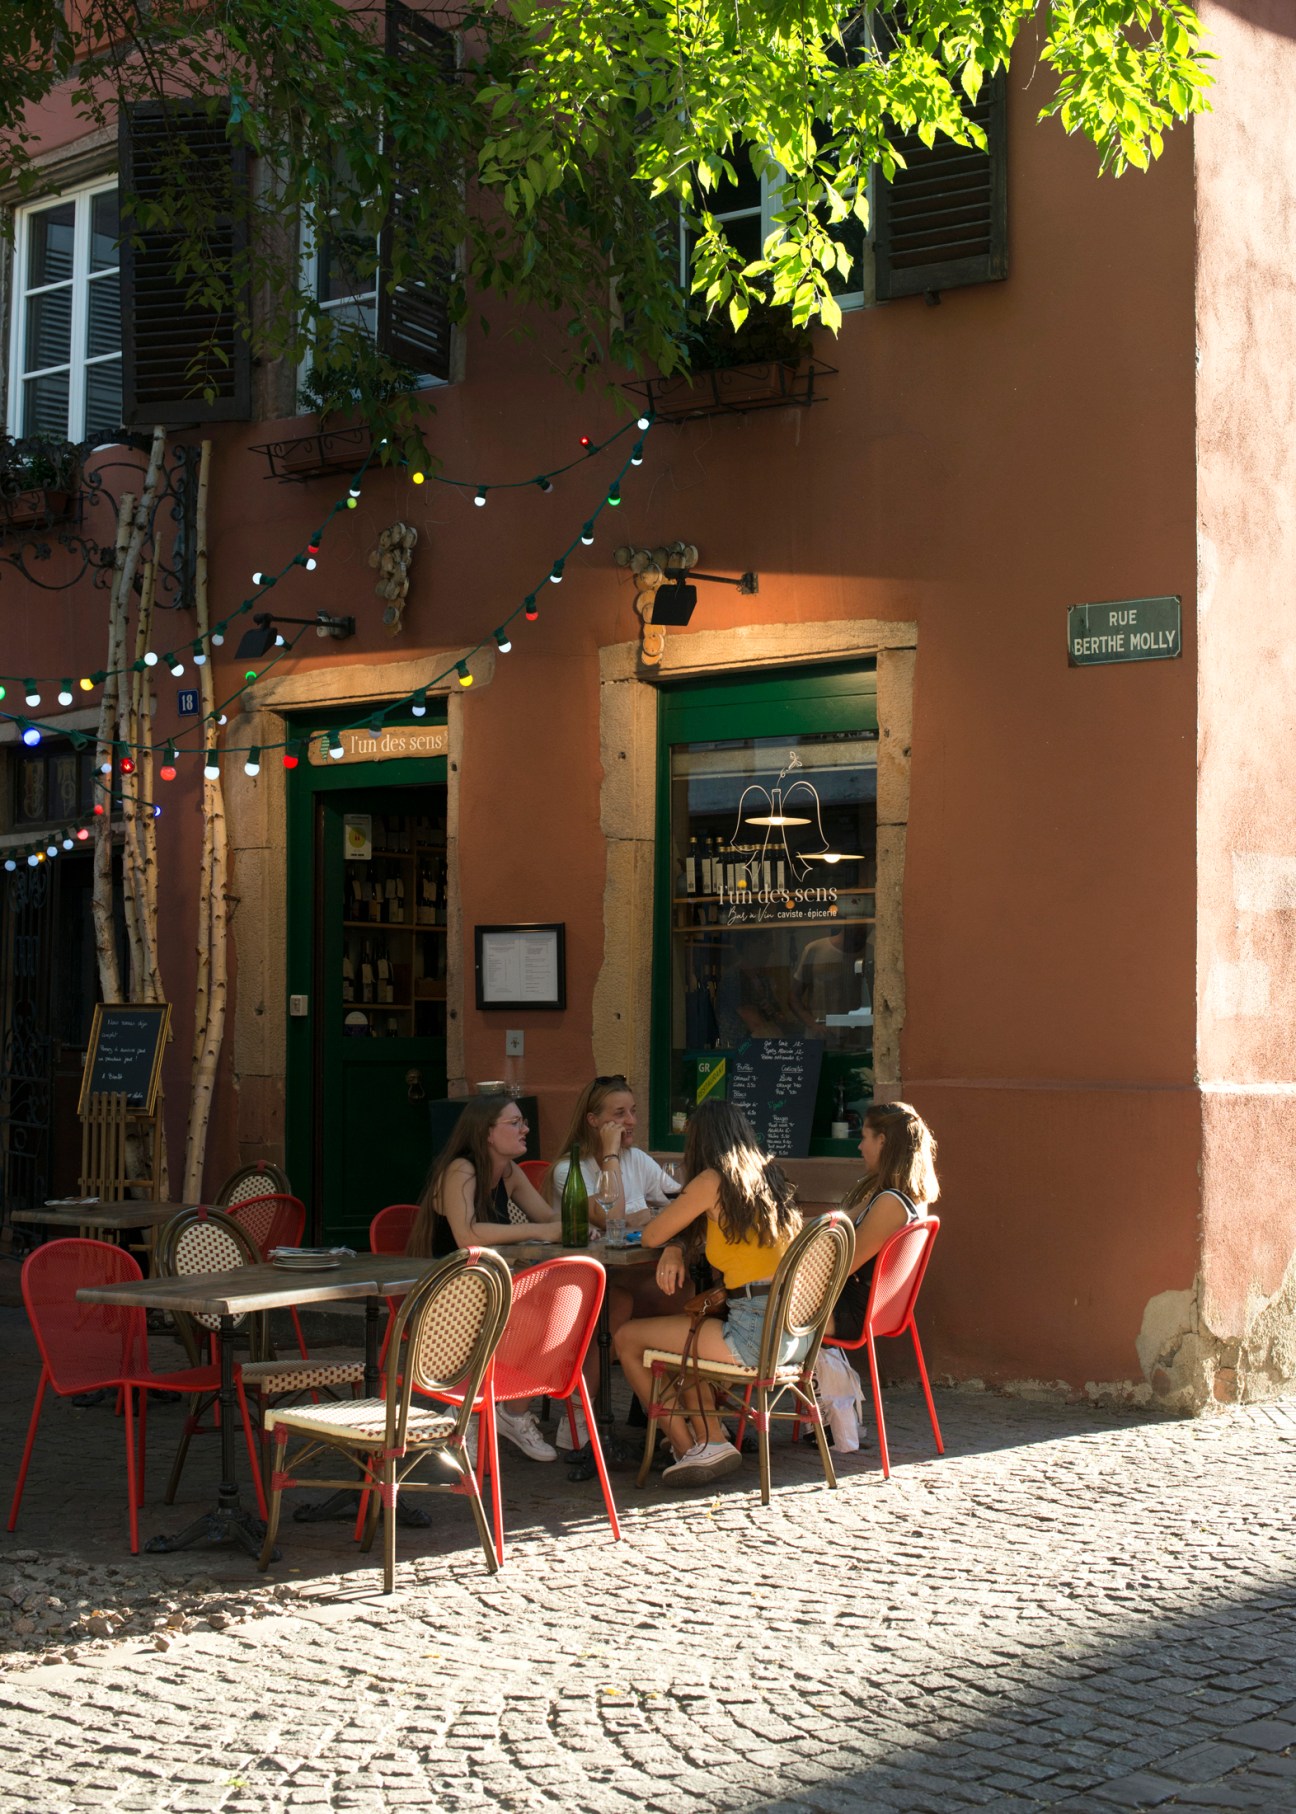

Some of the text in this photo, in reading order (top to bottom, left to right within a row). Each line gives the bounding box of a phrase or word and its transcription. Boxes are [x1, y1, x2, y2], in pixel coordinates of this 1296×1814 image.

[1109, 609, 1138, 627] RUE
[1130, 630, 1176, 651] MOLLY
[182, 694, 193, 711] 18
[350, 735, 378, 754] l'un
[380, 734, 406, 753] des
[757, 883, 790, 904] des
[794, 886, 838, 903] sens
[727, 905, 748, 926] Bar
[757, 902, 775, 923] Vin
[777, 909, 803, 919] caviste
[807, 908, 837, 919] épicerie
[698, 1062, 711, 1073] GR
